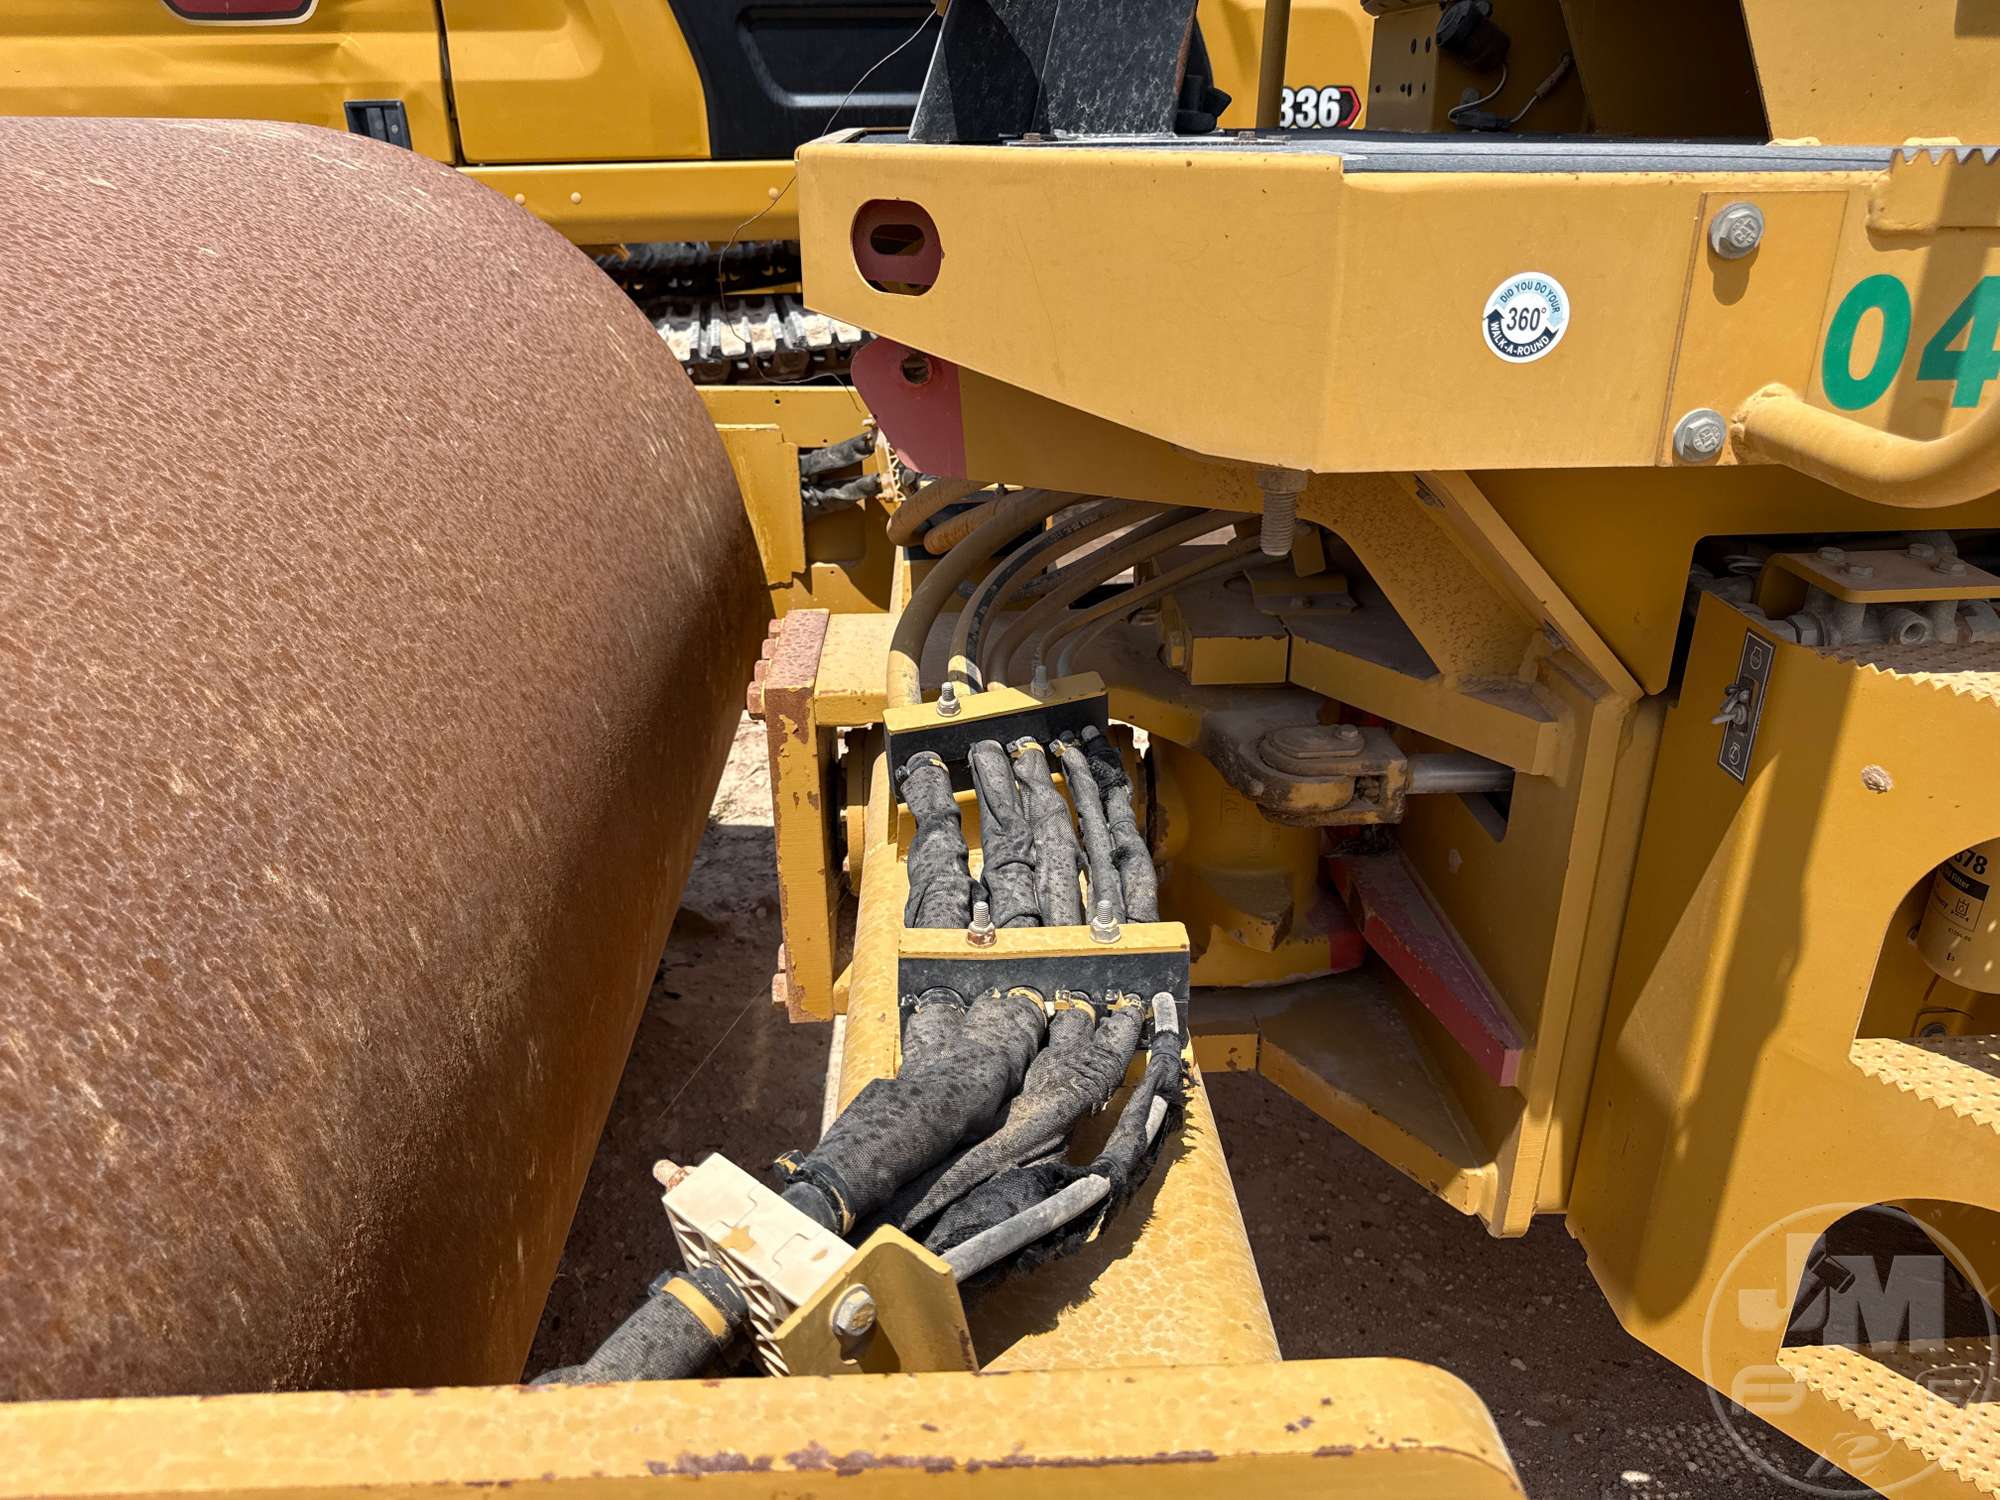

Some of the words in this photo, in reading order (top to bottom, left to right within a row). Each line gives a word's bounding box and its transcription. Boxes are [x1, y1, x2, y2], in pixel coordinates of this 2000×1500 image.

[1279, 87, 1341, 128] 336
[1500, 289, 1514, 303] DID
[1515, 281, 1533, 292] YOU
[1535, 282, 1547, 293] DO
[1546, 289, 1561, 313] YOUR
[1506, 307, 1547, 331] 360°
[1822, 274, 2000, 411] 04
